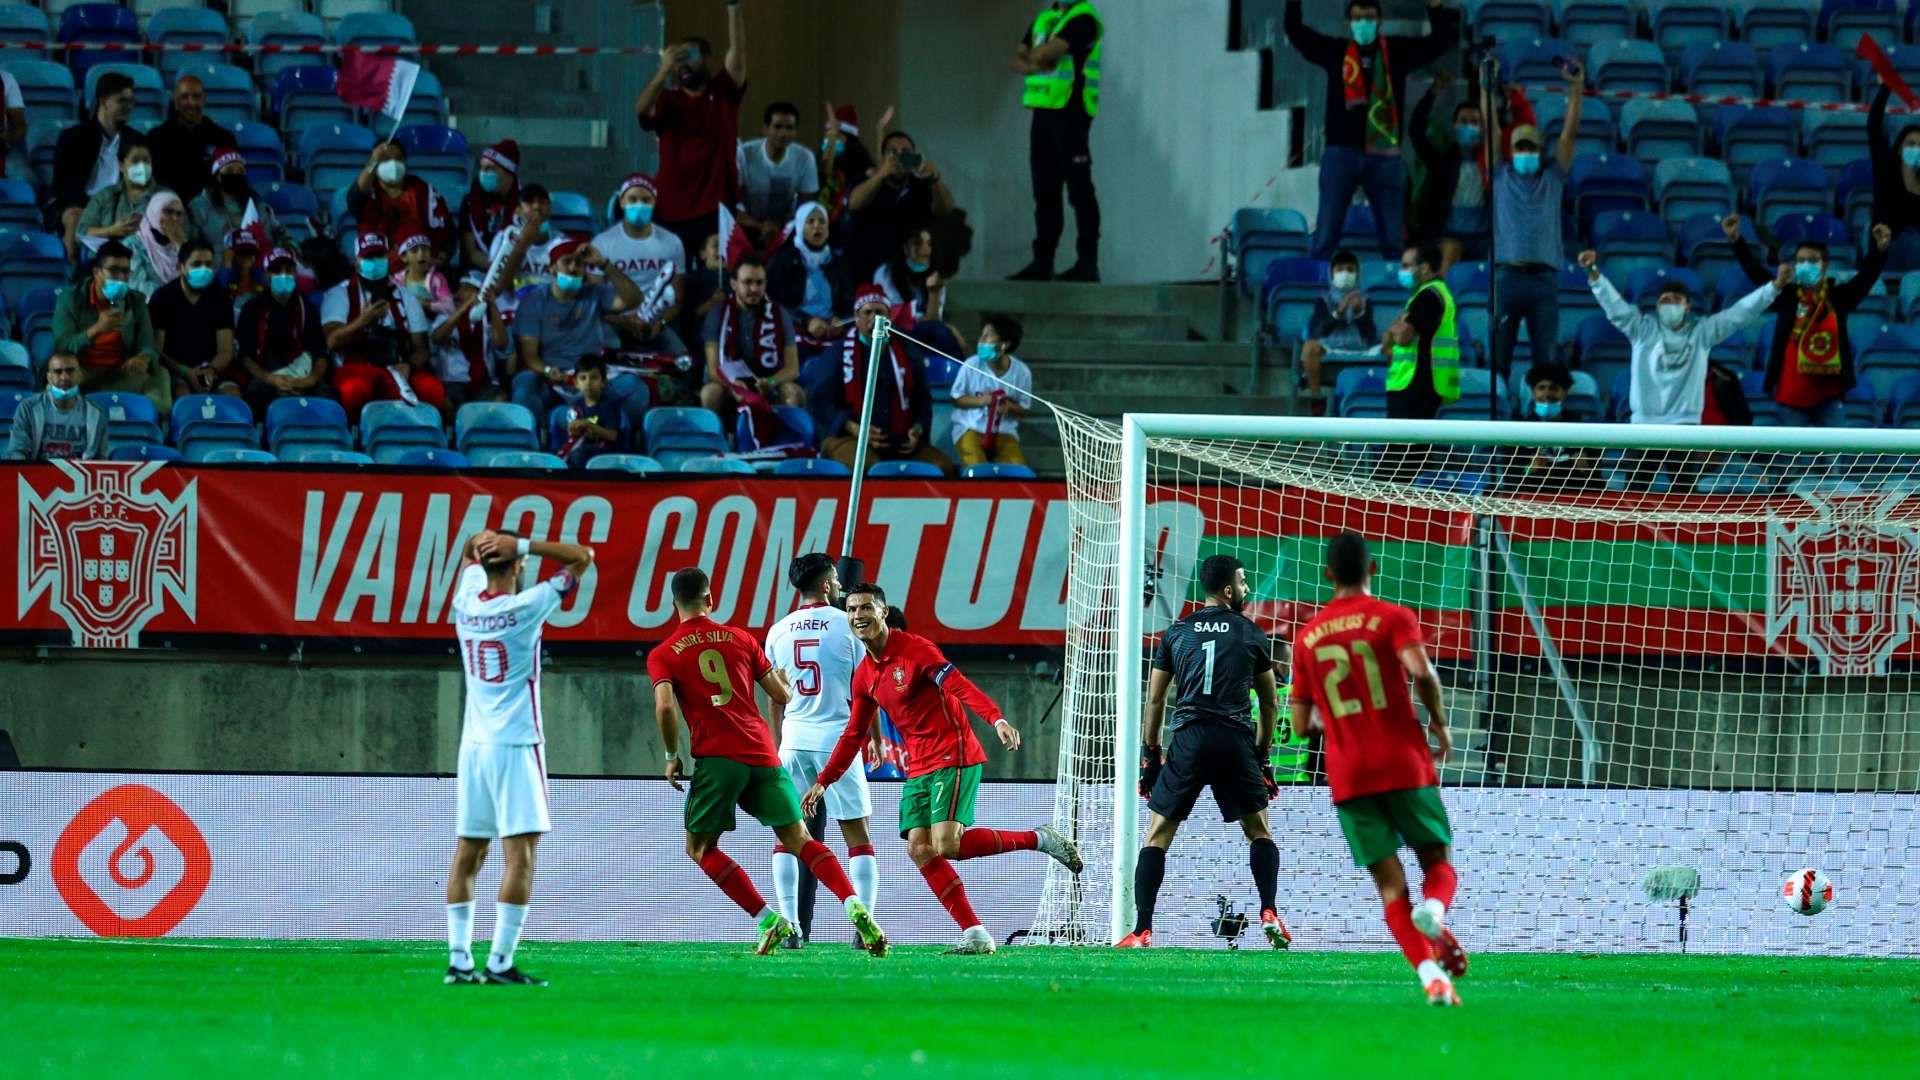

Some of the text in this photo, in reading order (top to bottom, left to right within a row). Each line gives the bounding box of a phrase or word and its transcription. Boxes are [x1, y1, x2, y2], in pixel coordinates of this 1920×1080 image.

[627, 495, 838, 629] COM
[670, 629, 734, 655] ANDRÉ SILVA
[789, 619, 830, 632] TAREK
[1193, 621, 1230, 633] SAAD
[465, 639, 508, 684] 10
[698, 649, 733, 707] 9
[793, 639, 821, 696] 5
[1201, 640, 1216, 695] 1
[1315, 639, 1388, 719] 21
[934, 781, 945, 804] 7
